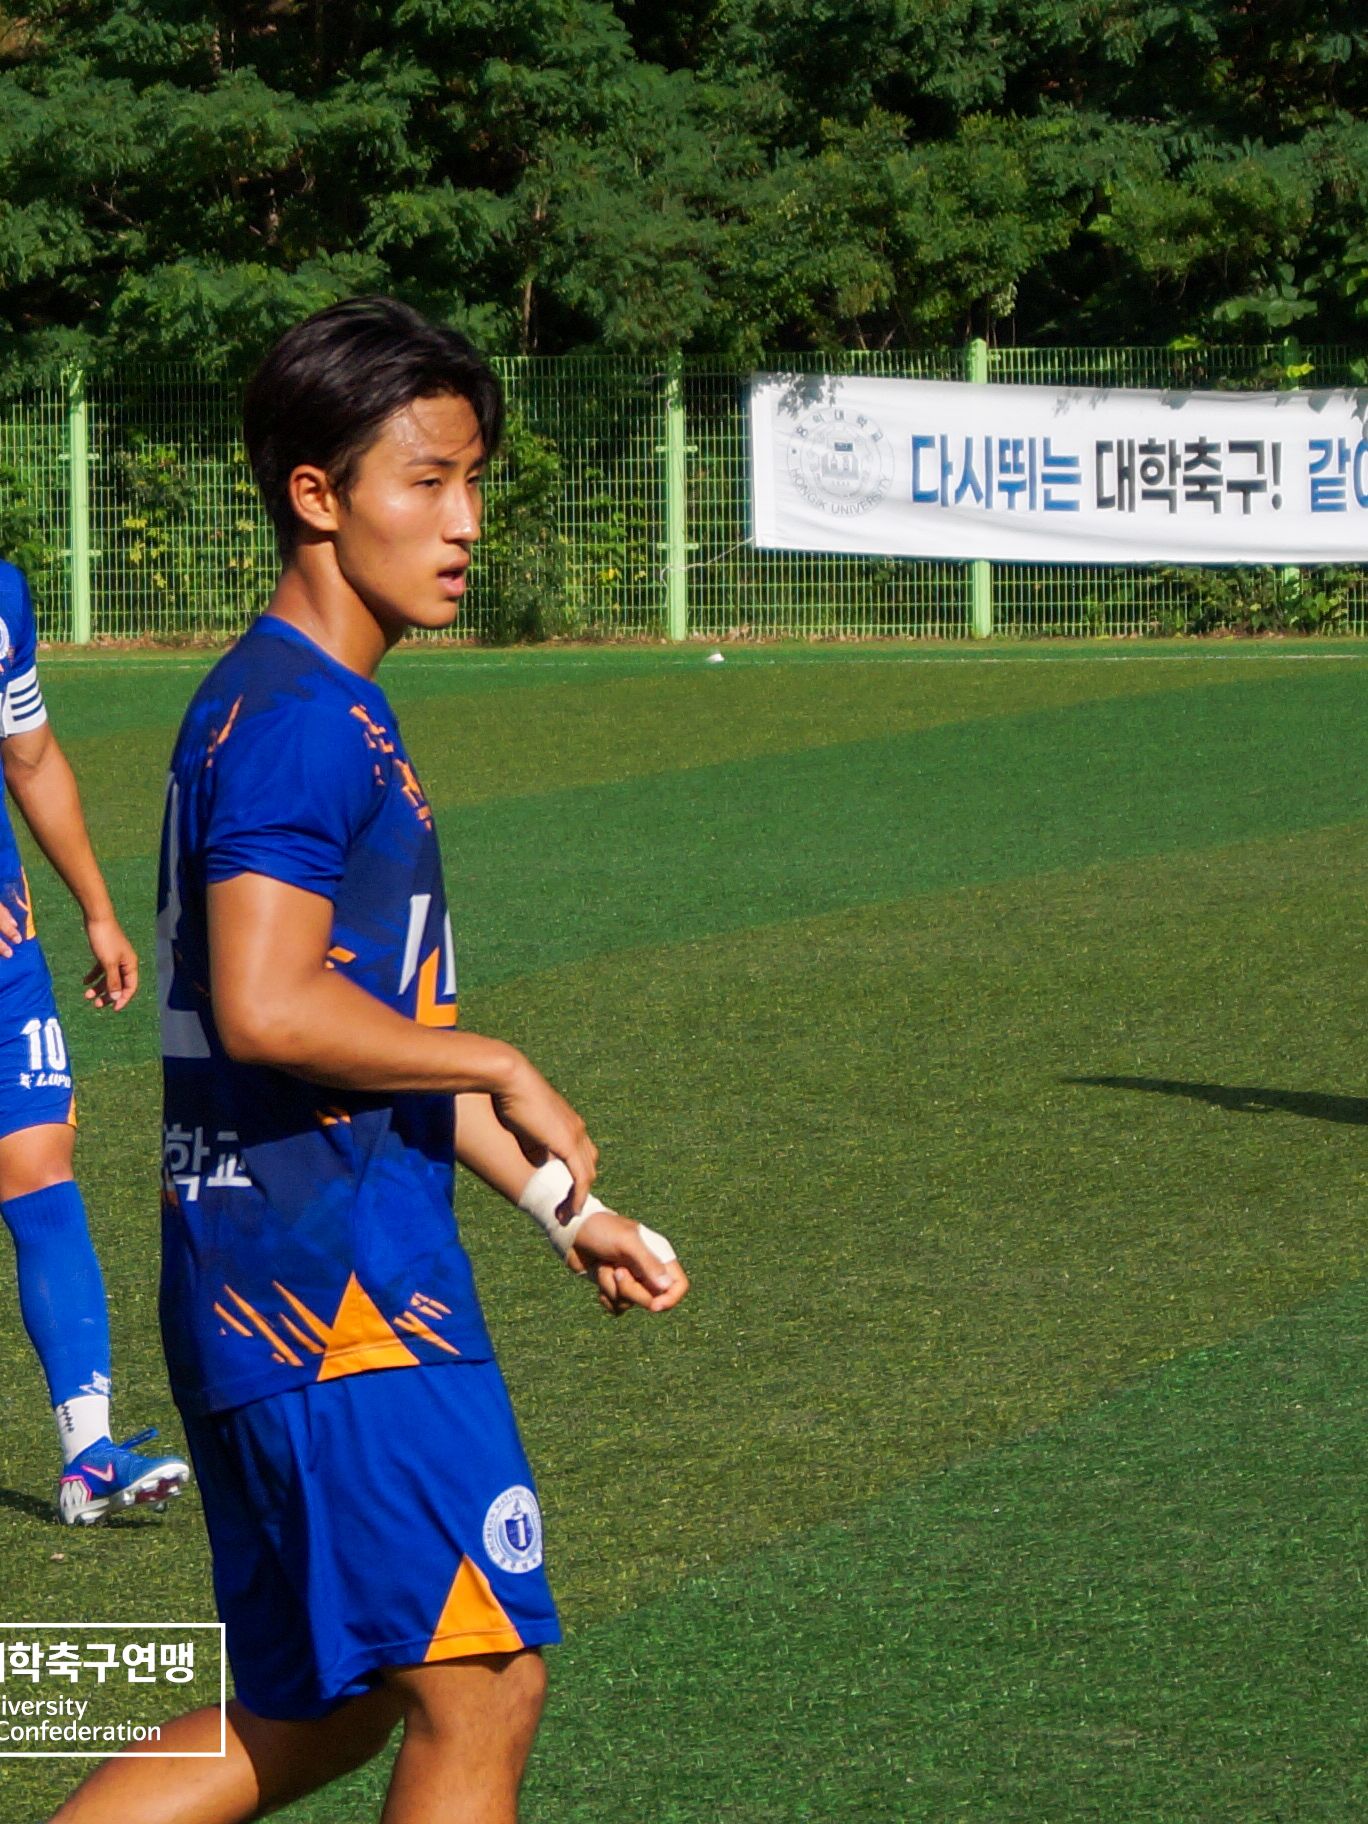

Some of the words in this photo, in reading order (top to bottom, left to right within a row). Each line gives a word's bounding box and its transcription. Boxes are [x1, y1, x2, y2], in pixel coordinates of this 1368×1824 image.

[911, 434, 1081, 512] 다시뛰는
[1096, 436, 1282, 514] 대학축구!
[20, 1018, 66, 1071] 10
